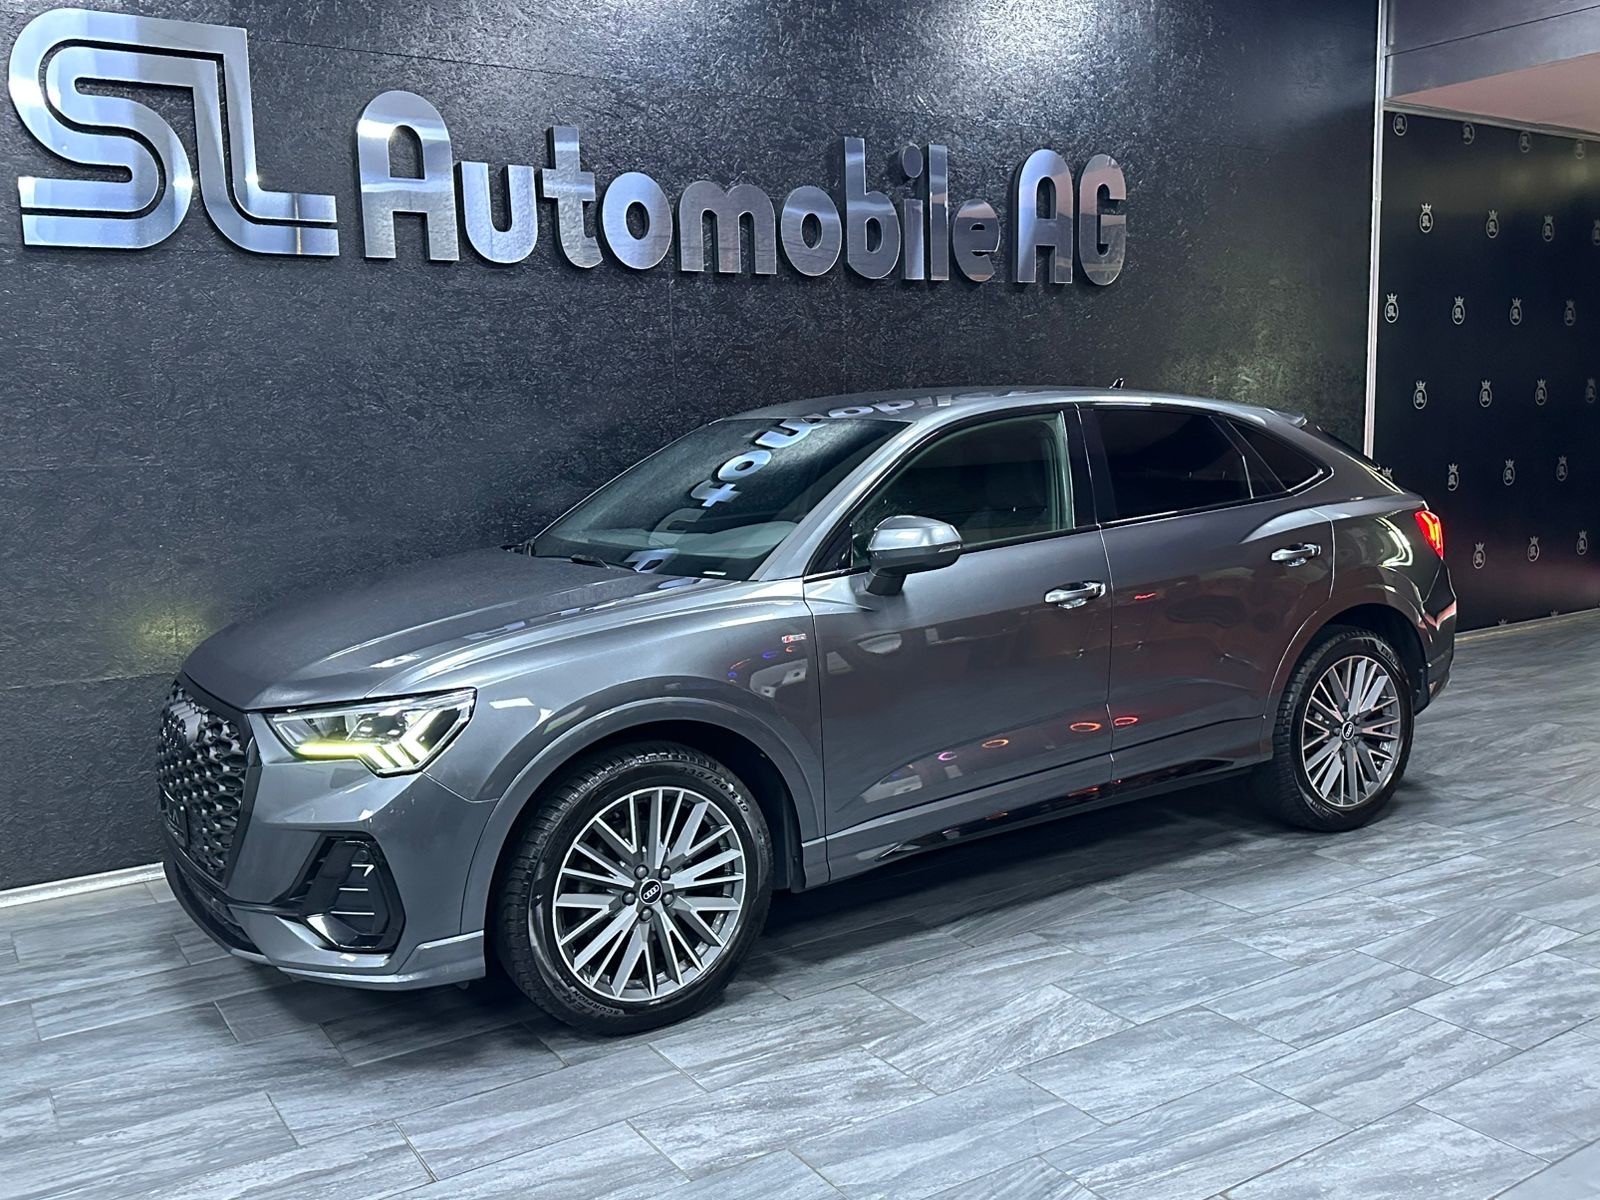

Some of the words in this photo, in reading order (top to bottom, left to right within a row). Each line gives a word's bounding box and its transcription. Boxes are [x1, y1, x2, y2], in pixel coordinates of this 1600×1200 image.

[8, 8, 340, 258] SL
[356, 90, 1001, 282] Automobile
[1016, 149, 1127, 286] AG
